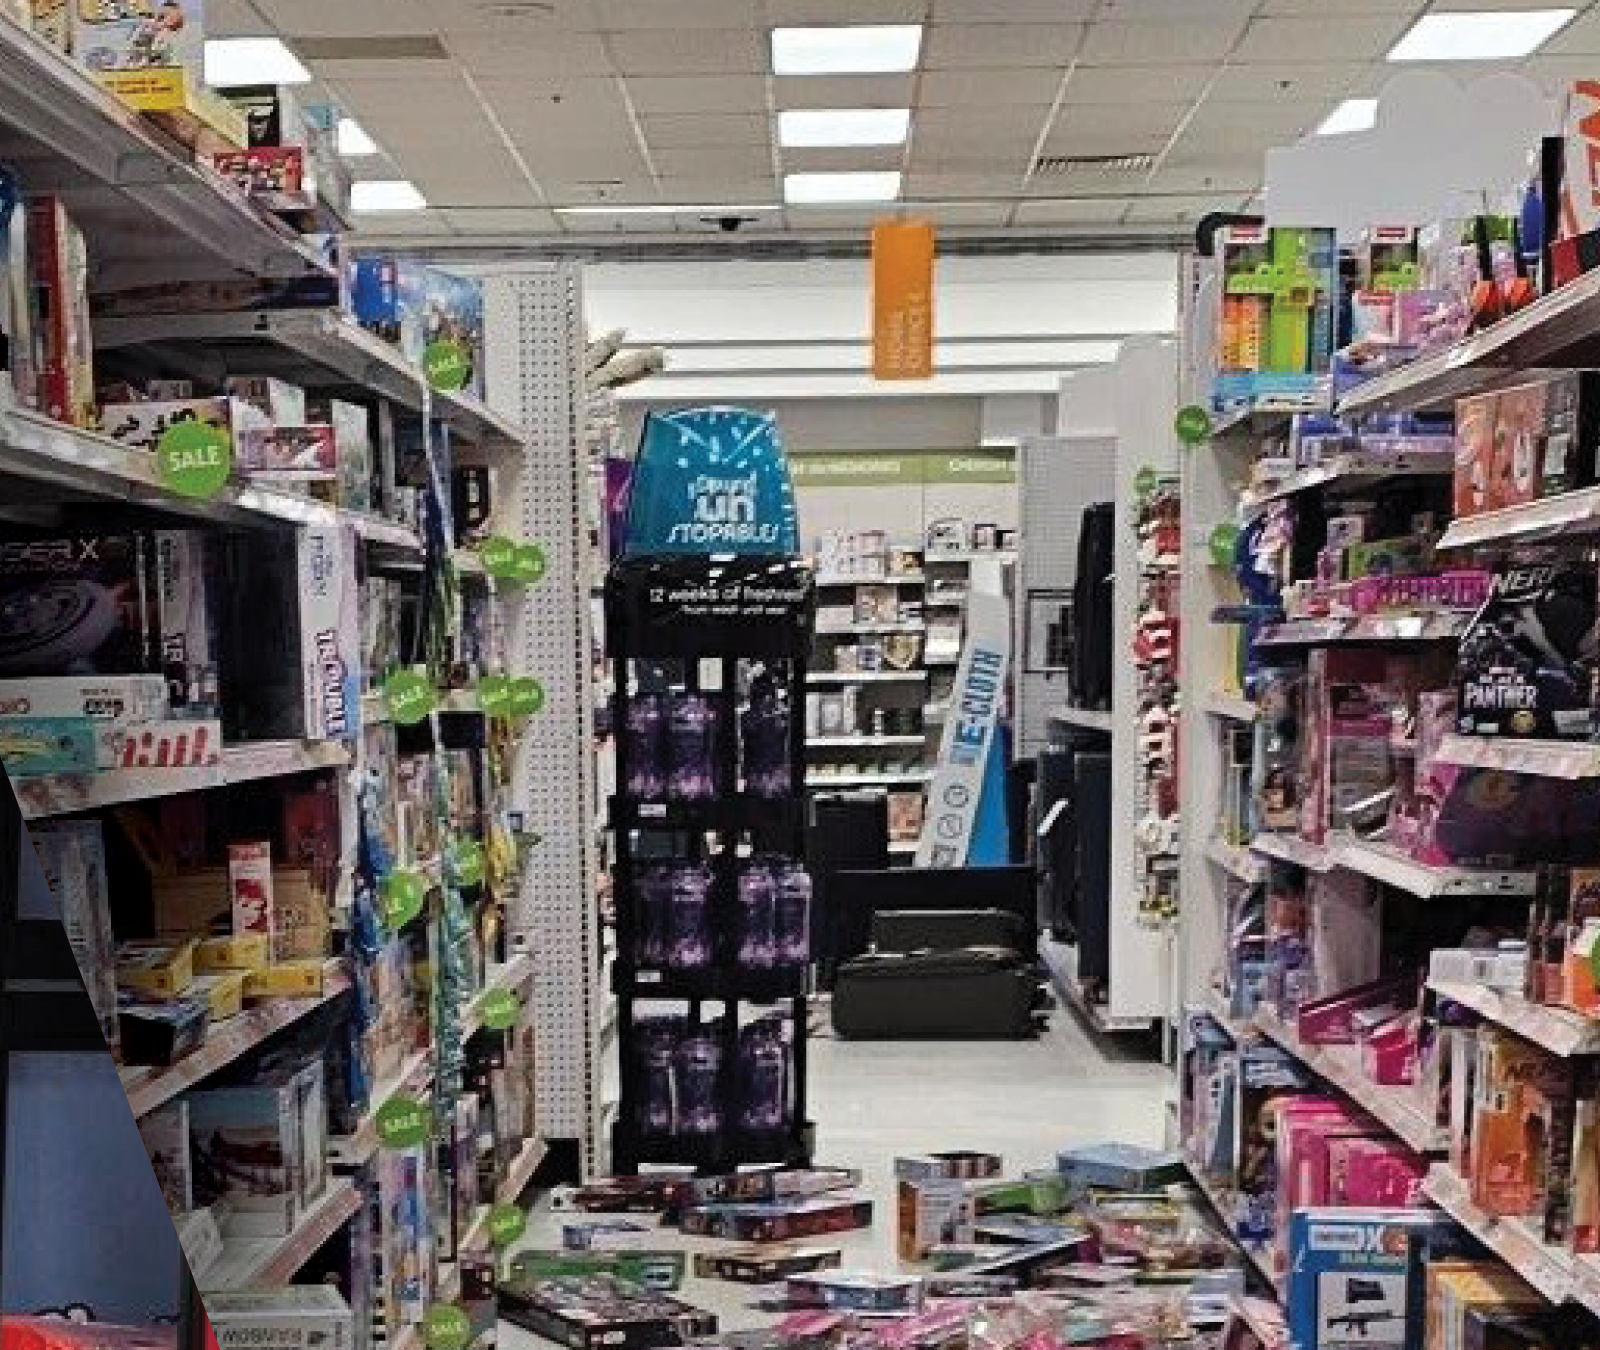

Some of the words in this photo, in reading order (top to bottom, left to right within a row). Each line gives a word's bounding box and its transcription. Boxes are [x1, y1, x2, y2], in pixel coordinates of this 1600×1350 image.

[169, 445, 221, 472] SALE
[693, 495, 754, 522] un
[666, 523, 779, 543] STOPABLES
[79, 537, 99, 562] X
[668, 586, 720, 602] weeks
[722, 585, 742, 601] of
[315, 629, 349, 734] TROUBLE
[1462, 681, 1539, 710] PANTHER
[221, 1326, 302, 1345] RAINBOW
